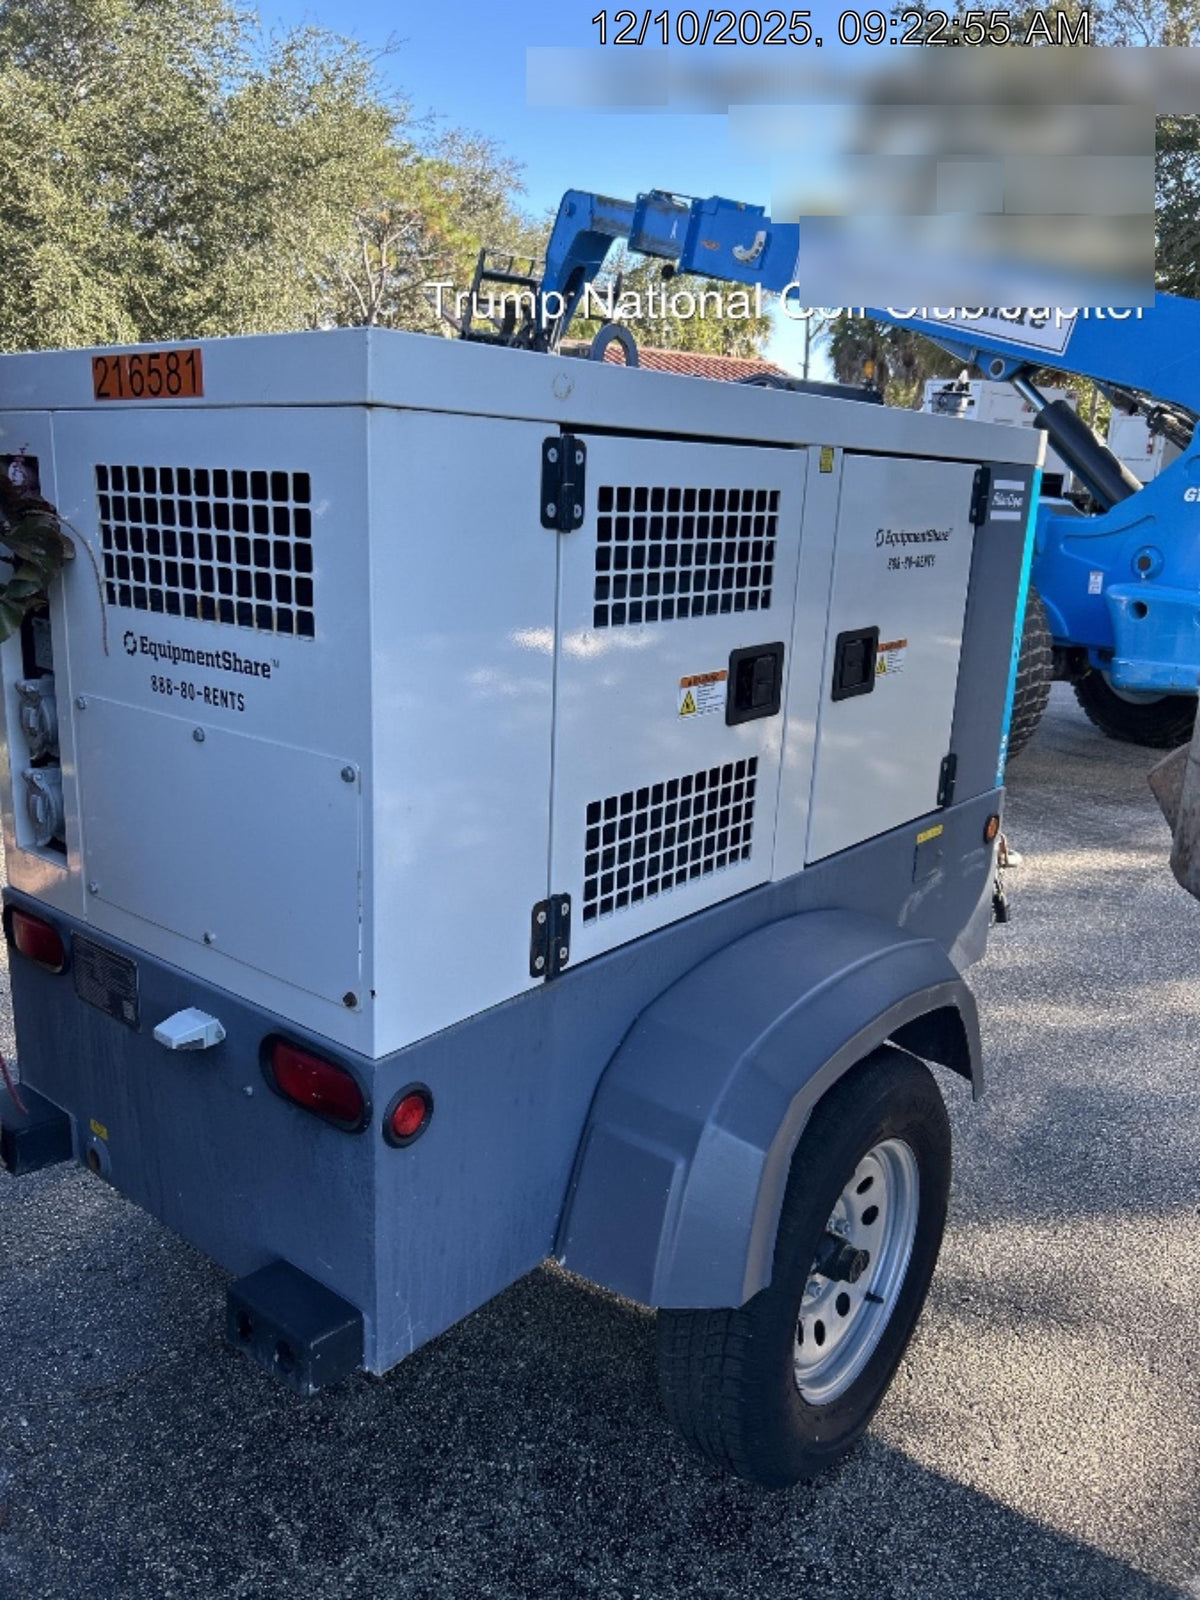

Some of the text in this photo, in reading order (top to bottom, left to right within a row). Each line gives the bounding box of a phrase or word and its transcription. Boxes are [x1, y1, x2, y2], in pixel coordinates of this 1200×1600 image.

[95, 349, 197, 398] 216581
[139, 635, 271, 679] EquipmentShare
[150, 674, 246, 712] 888-80-RENTS
